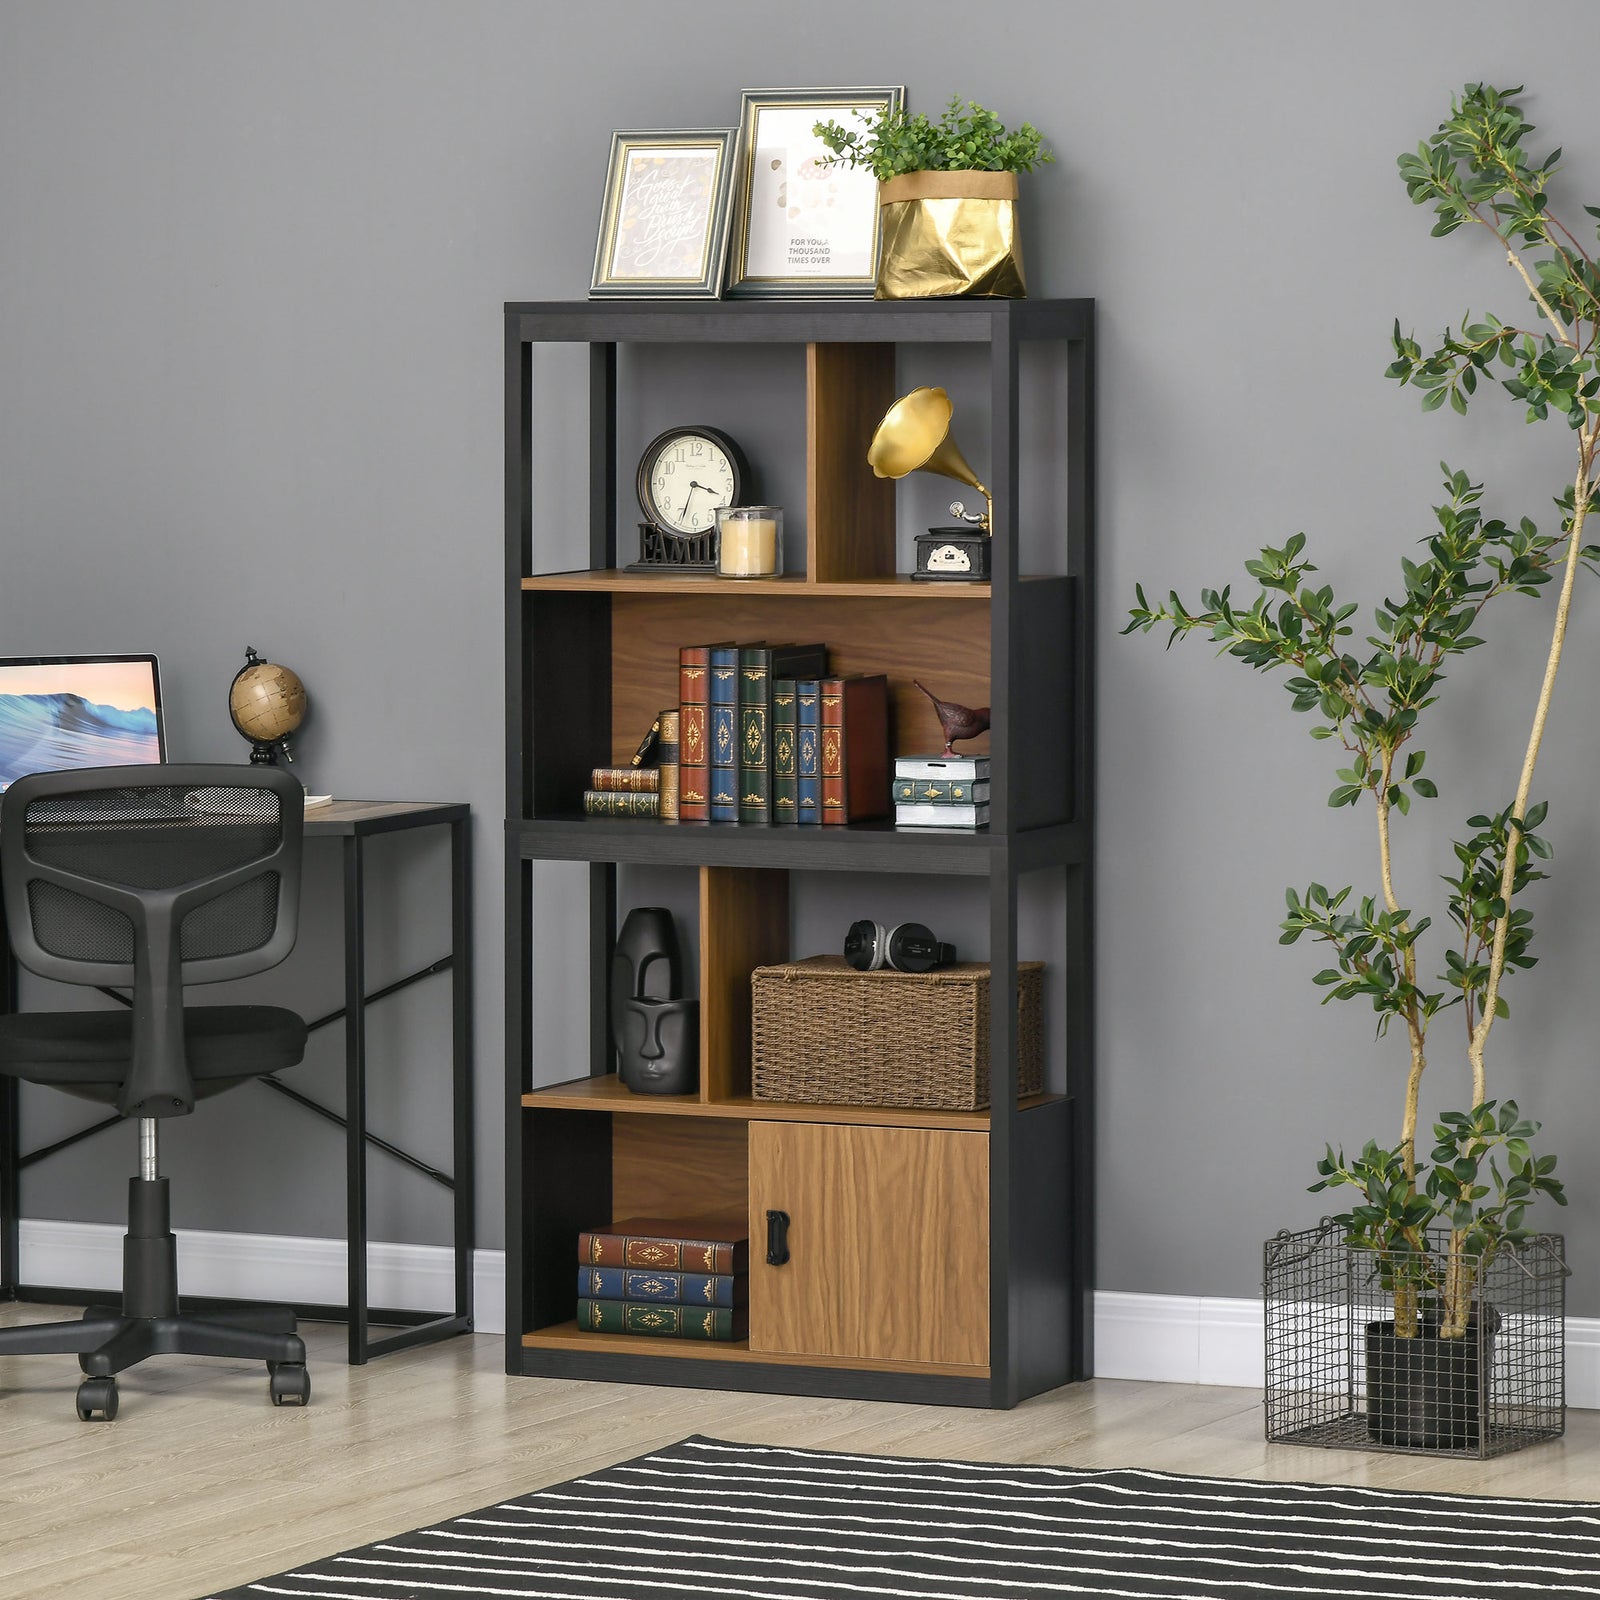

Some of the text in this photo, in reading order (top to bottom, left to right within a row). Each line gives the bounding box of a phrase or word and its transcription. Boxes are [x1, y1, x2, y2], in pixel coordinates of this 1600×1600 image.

[790, 238, 806, 246] FOR
[789, 247, 831, 255] THOUSAND
[788, 256, 831, 264] TIMES OVER
[690, 442, 703, 457] 12
[709, 447, 715, 462] 1
[663, 460, 675, 475] 10
[719, 458, 728, 473] 2
[658, 477, 666, 491] 9
[726, 477, 733, 493] 3
[663, 495, 672, 511] 8
[691, 512, 699, 527] 6
